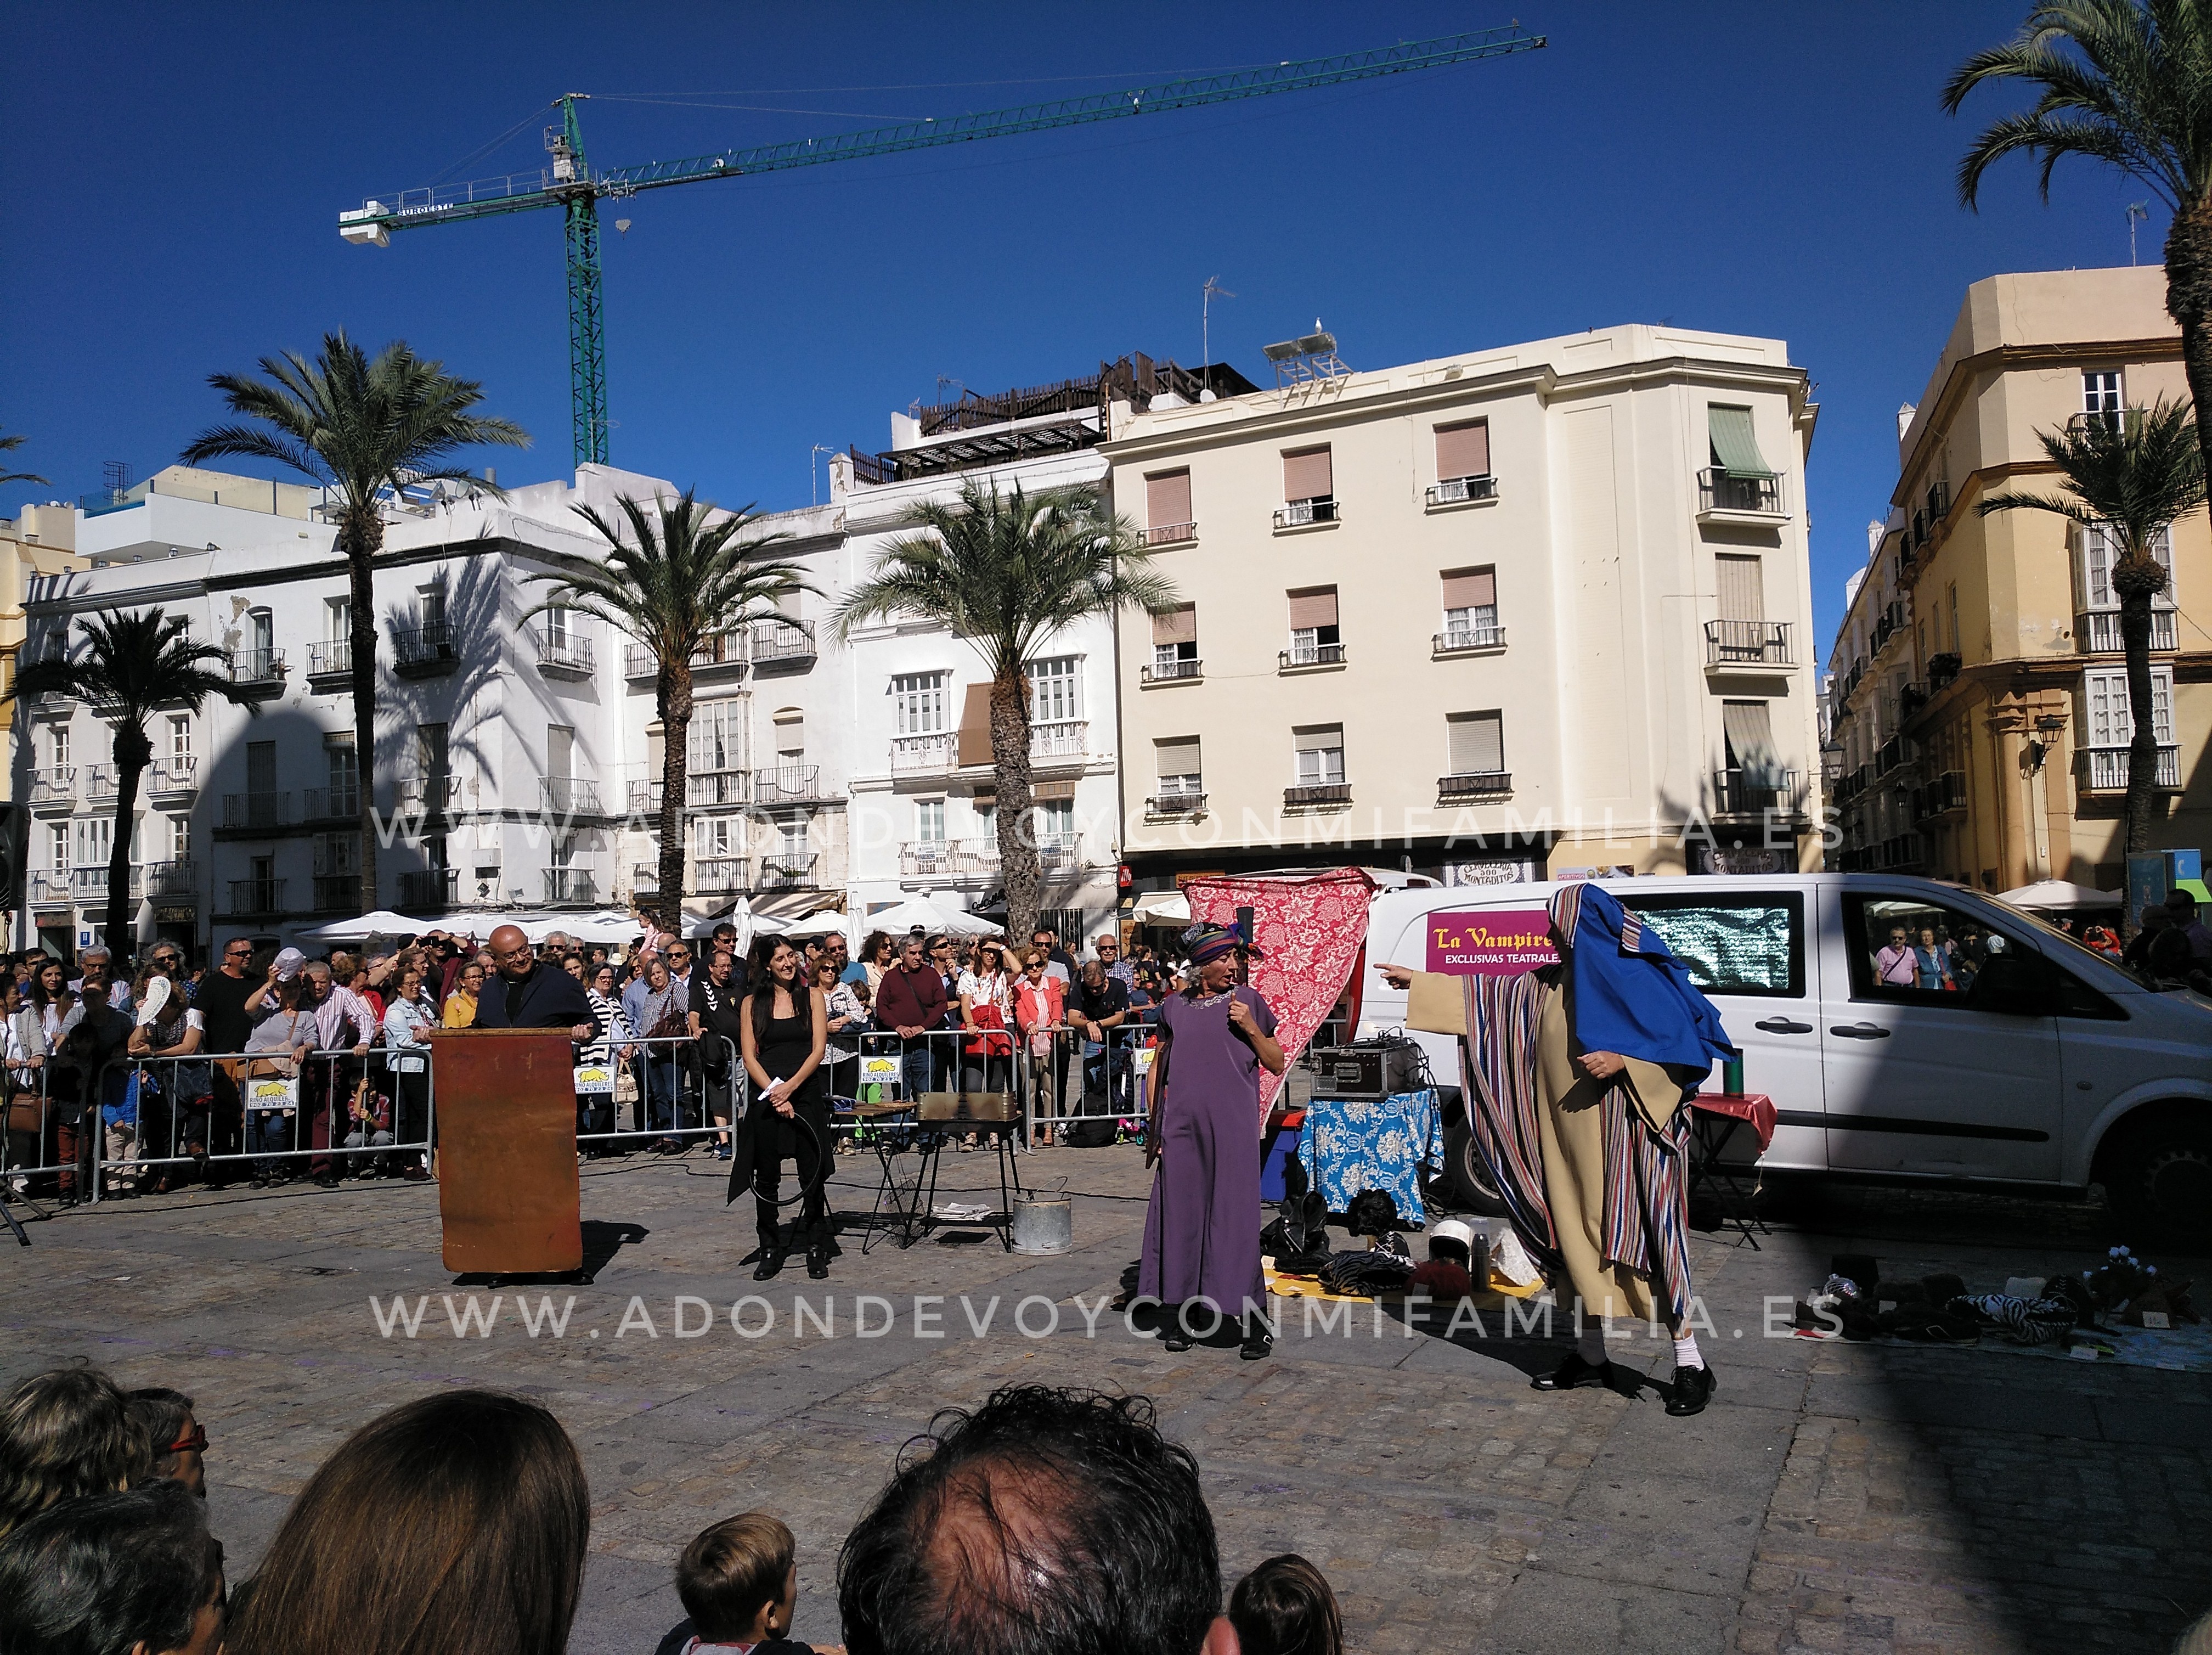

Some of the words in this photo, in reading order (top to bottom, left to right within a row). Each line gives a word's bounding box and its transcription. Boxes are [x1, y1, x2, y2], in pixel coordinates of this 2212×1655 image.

[397, 202, 453, 216] SUROESTE
[1121, 868, 1132, 885] illy
[1464, 871, 1514, 886] MONTADITOS
[1433, 928, 1462, 948] La
[1445, 953, 1504, 964] EXCLUSIVAS
[1506, 953, 1562, 963] TEATRALE
